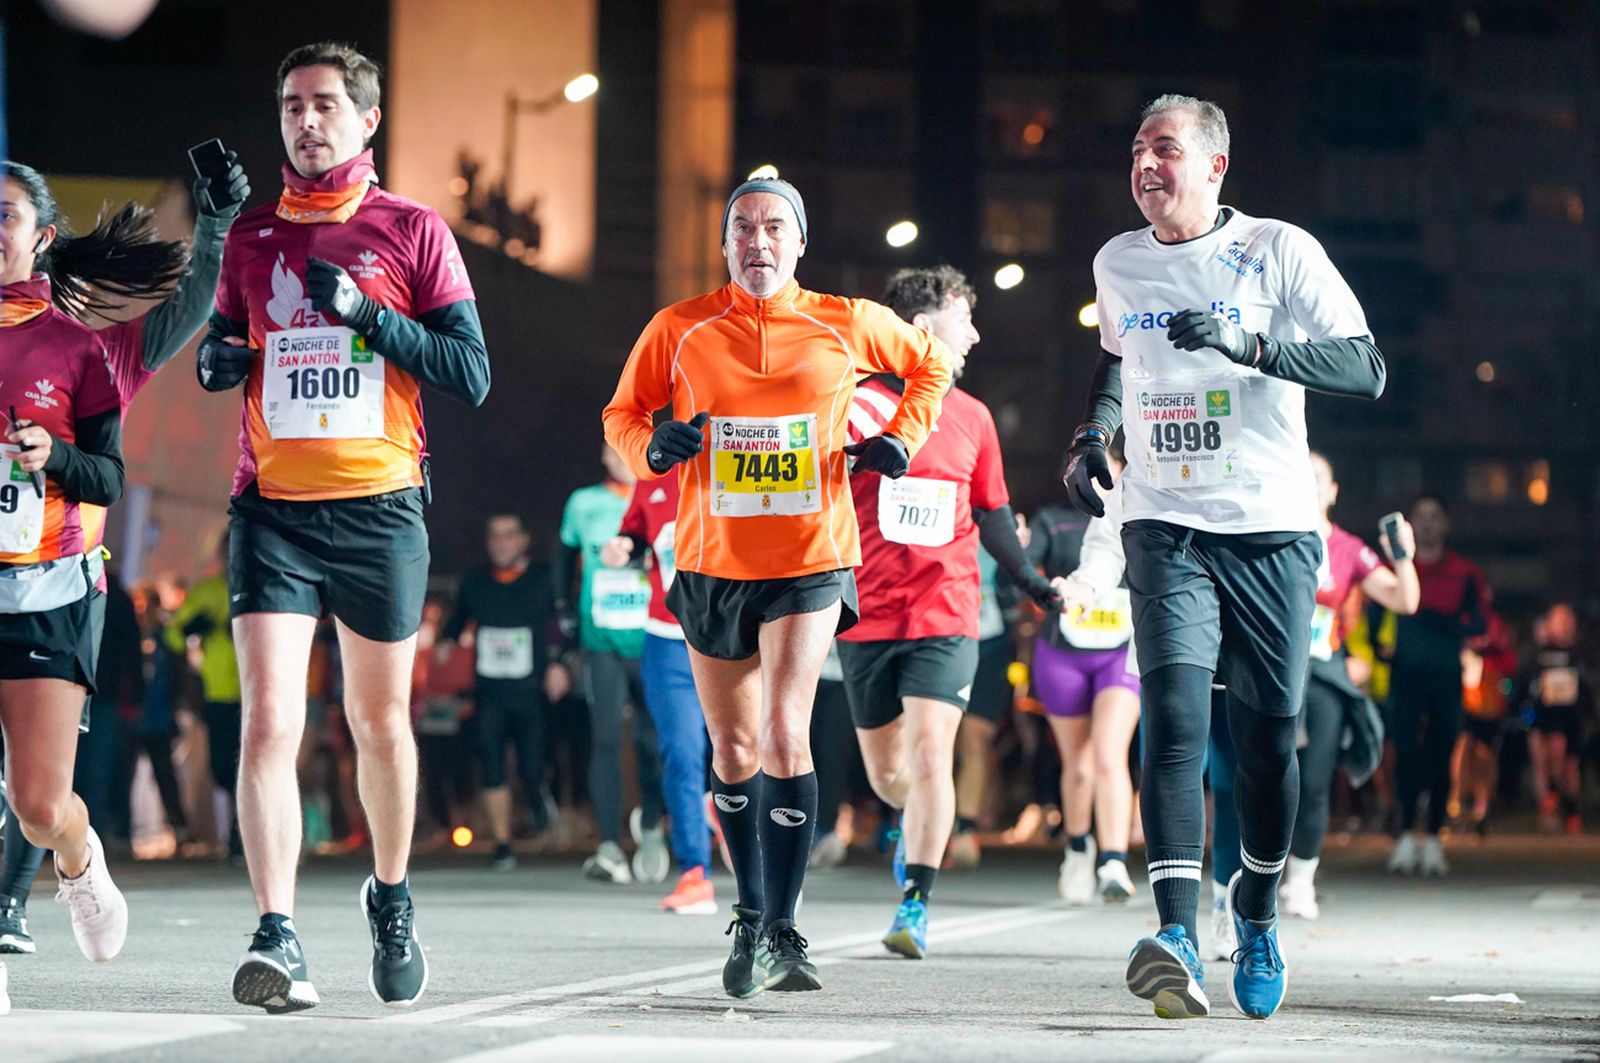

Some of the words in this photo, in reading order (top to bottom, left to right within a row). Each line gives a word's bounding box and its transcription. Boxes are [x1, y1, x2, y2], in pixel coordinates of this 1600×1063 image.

[291, 340, 324, 352] NOCHE
[326, 339, 340, 350] DE
[278, 354, 299, 367] SAN
[301, 351, 340, 366] ANTÓN
[287, 367, 360, 400] 1600
[306, 402, 341, 410] Fernando
[1151, 396, 1181, 407] NOCHE
[1183, 396, 1196, 406] DE
[1143, 409, 1159, 420] SAN
[1161, 406, 1197, 420] ANTÓN
[735, 428, 765, 438] NOCHE
[767, 428, 780, 438] DE
[1150, 420, 1222, 453] 4998
[723, 440, 742, 451] SAN
[744, 438, 780, 451] ANTÓN
[733, 453, 798, 482] 7443
[755, 484, 777, 492] Carlos
[899, 504, 939, 528] 7027
